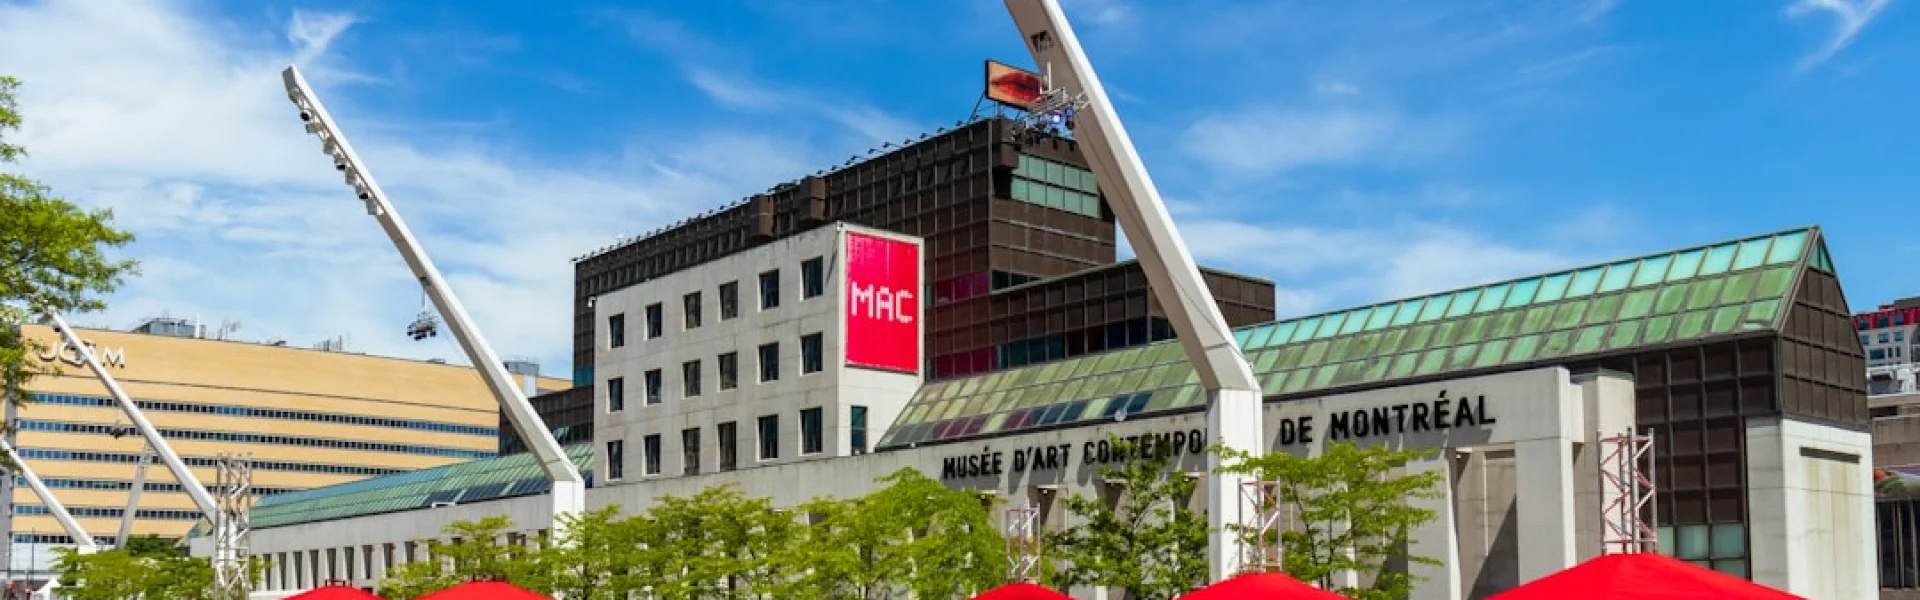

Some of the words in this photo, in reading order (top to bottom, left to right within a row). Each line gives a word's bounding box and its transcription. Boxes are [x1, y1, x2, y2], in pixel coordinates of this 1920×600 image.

[851, 281, 913, 323] MAC
[943, 445, 1002, 479] MUSÉE
[1014, 443, 1071, 472] D'ART
[1083, 428, 1207, 465] CONTEMPO
[1281, 416, 1312, 445] DE
[1331, 390, 1496, 440] MONTRÉAL
